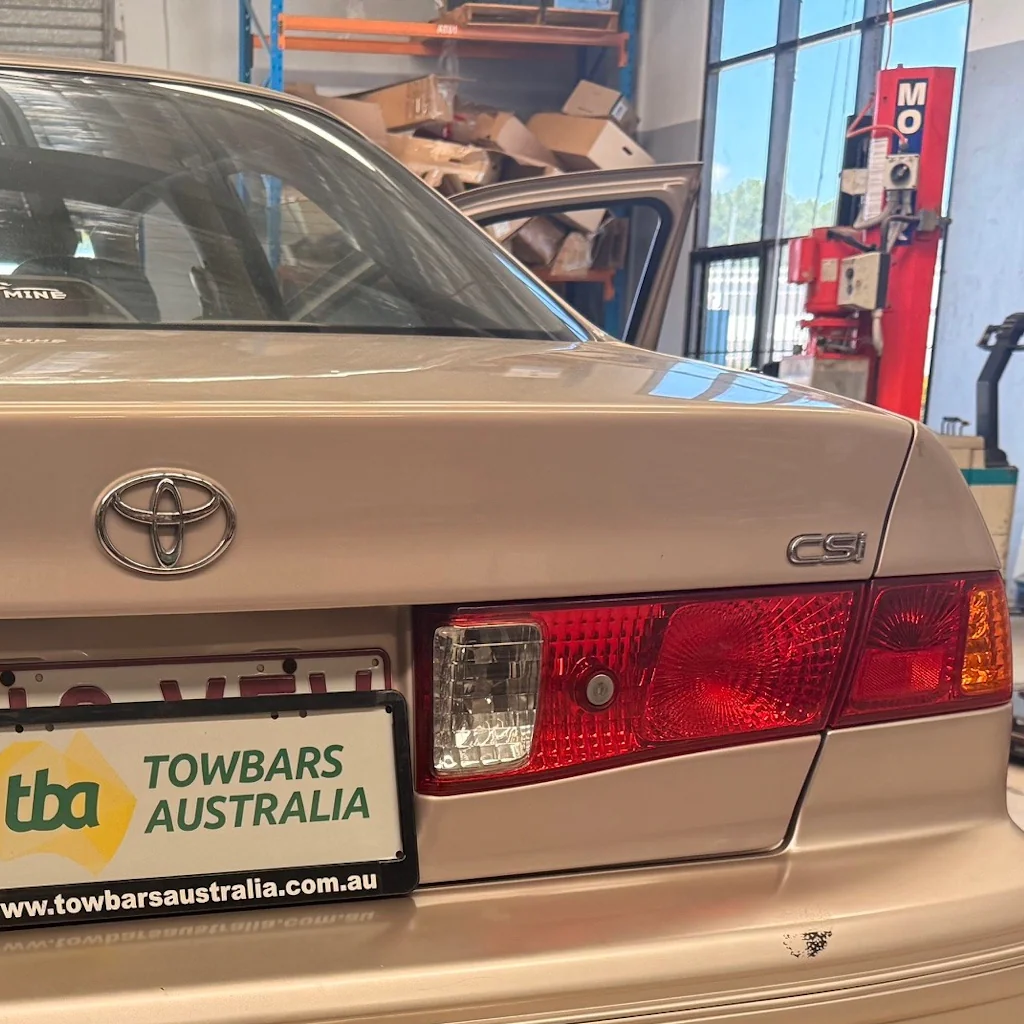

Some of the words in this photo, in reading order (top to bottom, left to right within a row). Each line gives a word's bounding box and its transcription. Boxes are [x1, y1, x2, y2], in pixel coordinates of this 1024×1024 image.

[143, 744, 344, 790] TOWBARS
[4, 767, 100, 834] tba
[144, 786, 371, 834] AUSTRALIA
